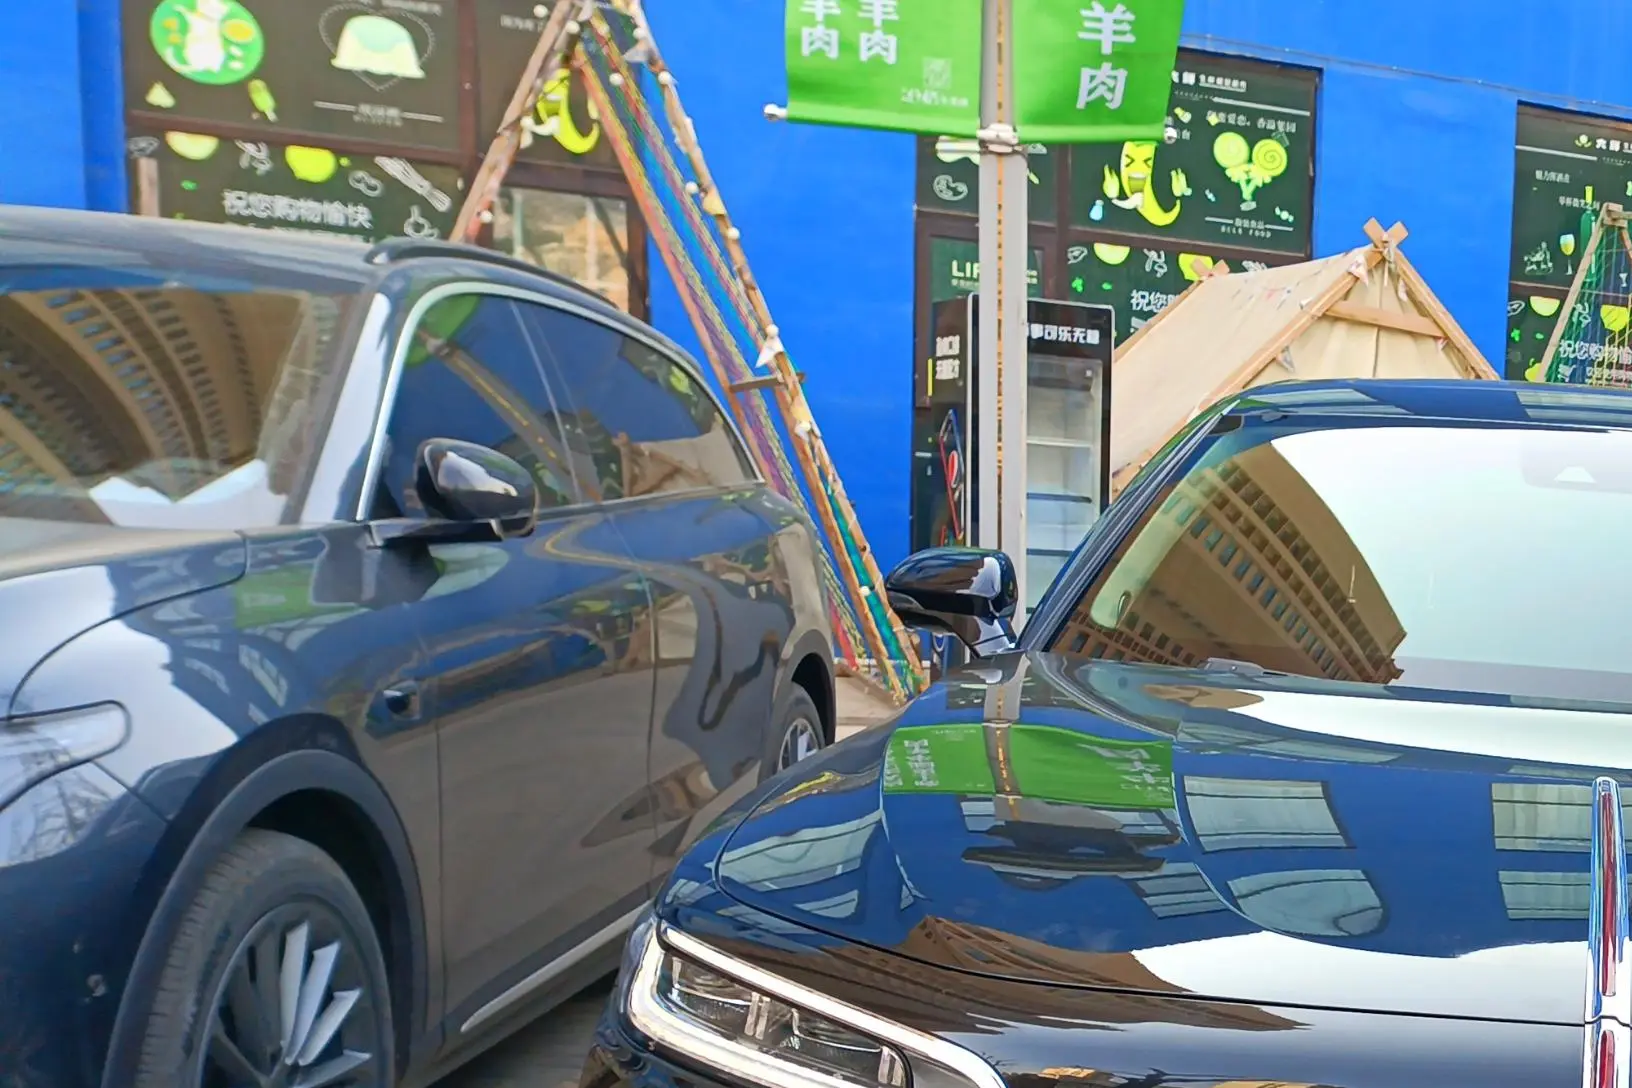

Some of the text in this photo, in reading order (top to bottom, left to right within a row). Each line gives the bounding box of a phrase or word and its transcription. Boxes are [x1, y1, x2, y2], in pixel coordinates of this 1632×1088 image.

[1076, 0, 1137, 110] 羊肉
[951, 259, 980, 279] LIF
[1026, 323, 1100, 345] 事可乐无糖
